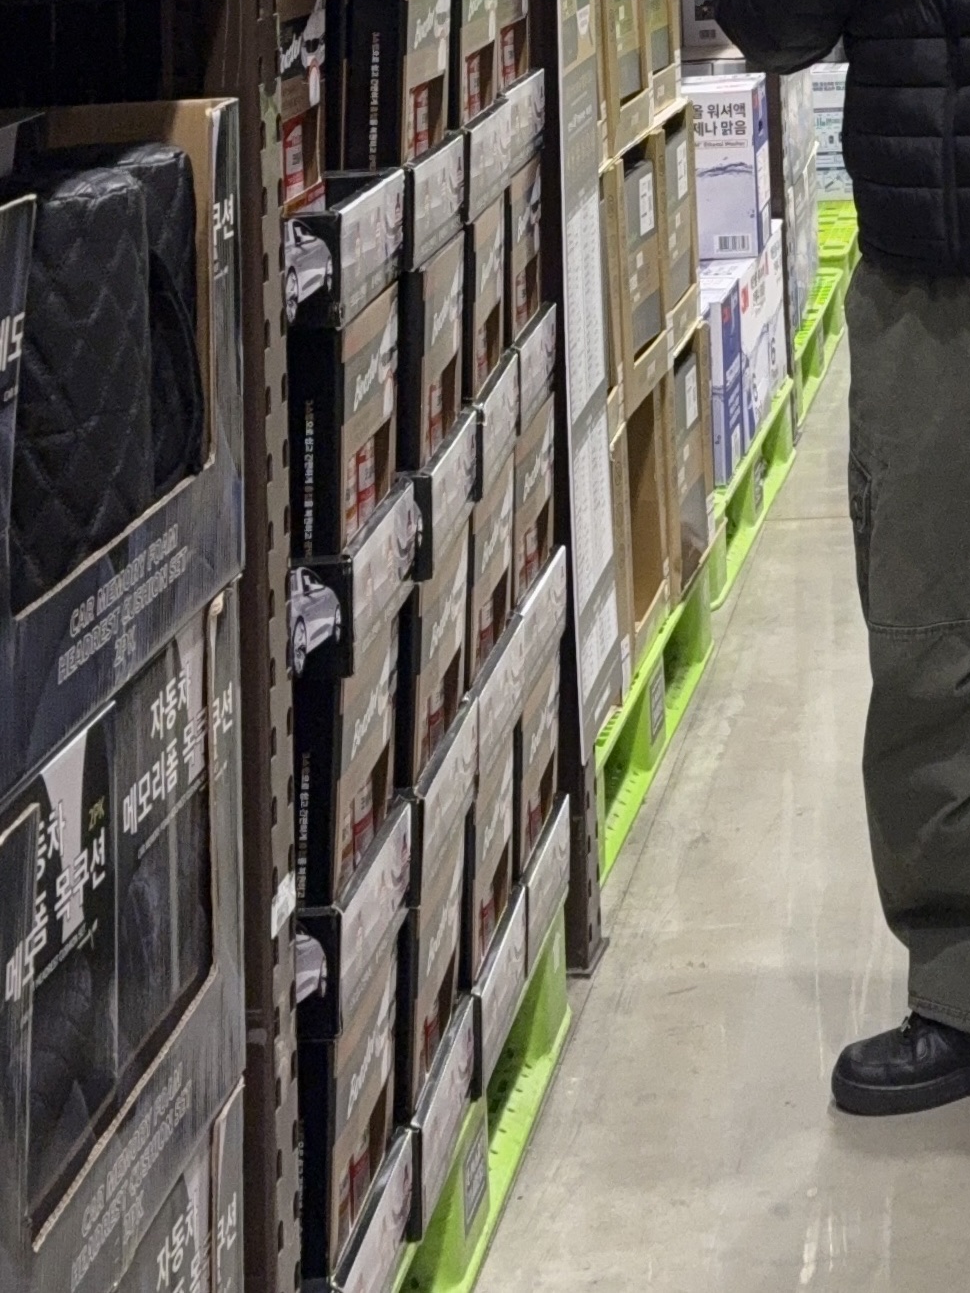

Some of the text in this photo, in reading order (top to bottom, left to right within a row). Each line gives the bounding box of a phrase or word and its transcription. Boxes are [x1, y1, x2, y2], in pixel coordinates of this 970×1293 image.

[707, 103, 746, 119] 워셔액
[721, 120, 747, 136] 맑음
[58, 546, 188, 685] HEADREST CUSHION SET
[70, 523, 179, 638] CAR MEMORY FOAM
[113, 624, 136, 668] 2PK
[150, 663, 191, 740] 자동차
[123, 737, 178, 835] 메모리폼
[54, 826, 106, 922] 목쿠션
[156, 1185, 200, 1293] 자동차
